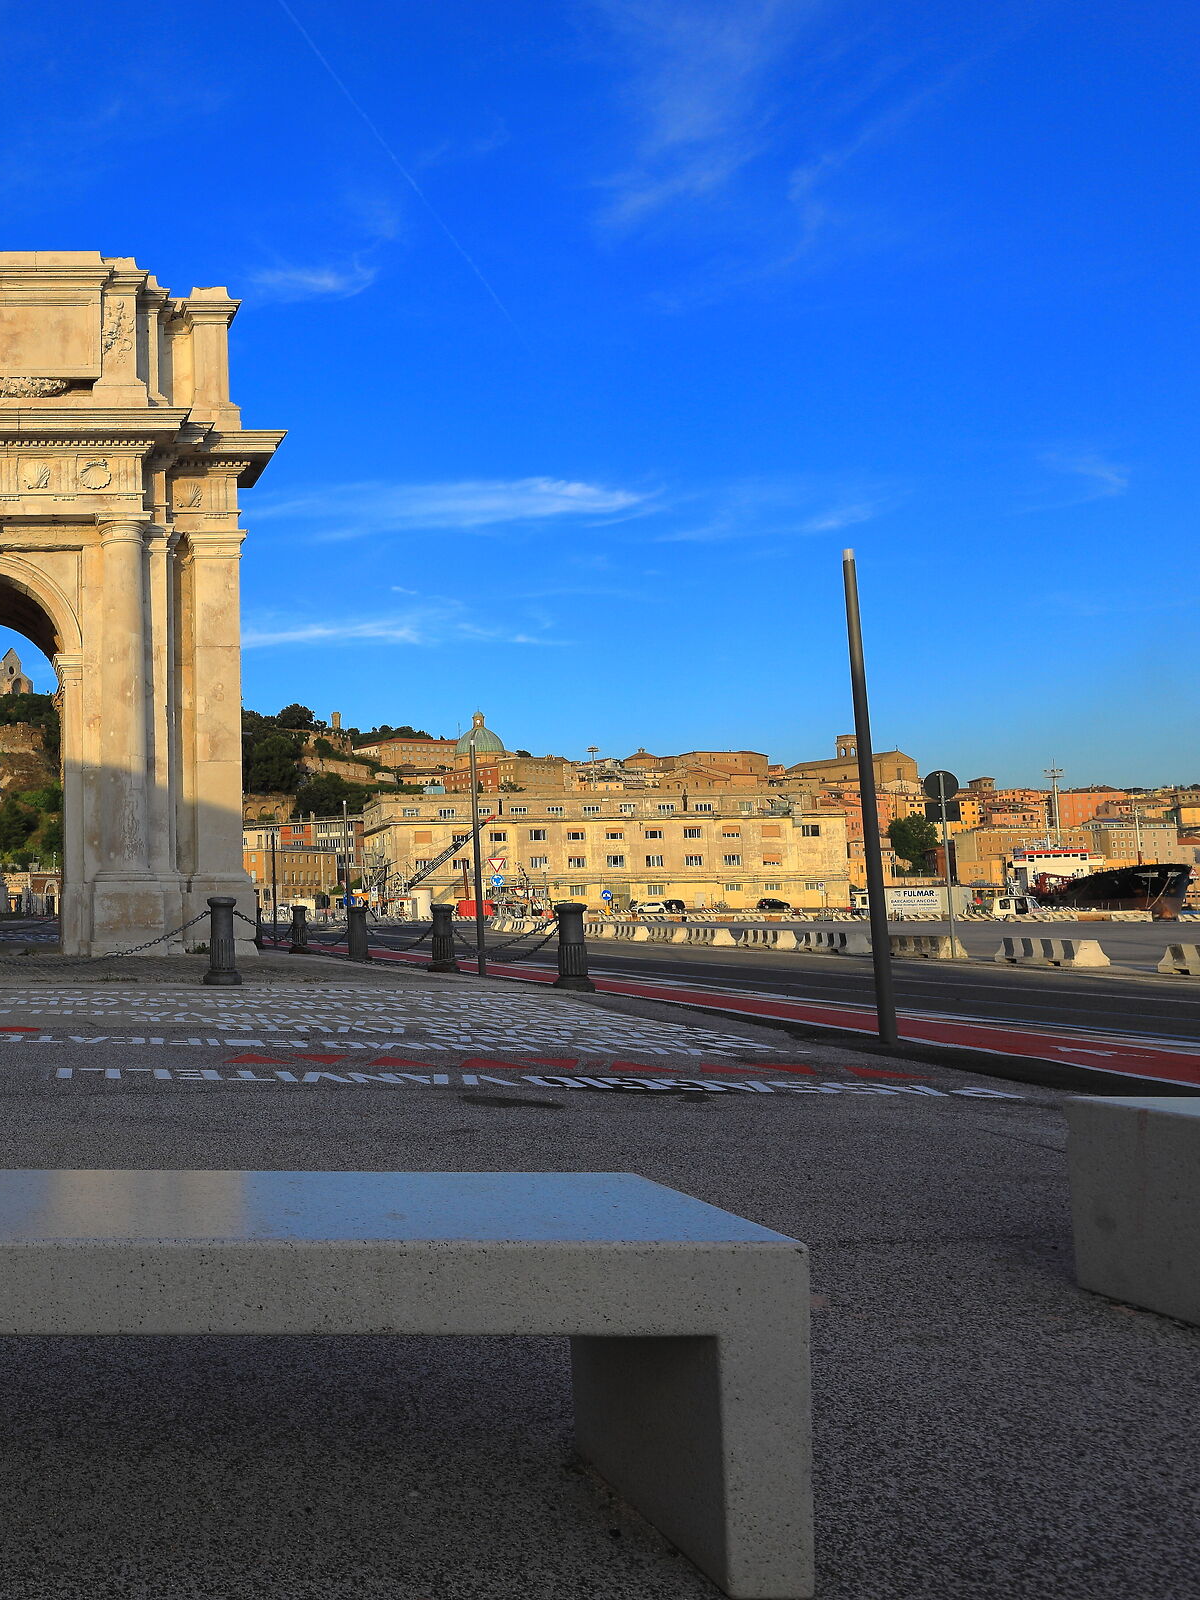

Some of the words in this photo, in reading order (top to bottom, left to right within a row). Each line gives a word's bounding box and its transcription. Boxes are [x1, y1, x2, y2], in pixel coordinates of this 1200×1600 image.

[130, 1016, 324, 1024] MENTE
[213, 1023, 415, 1033] AVUTO
[416, 1027, 587, 1037] AVER
[427, 1034, 700, 1046] ANCONA
[581, 1031, 759, 1041] DEVE
[316, 1040, 545, 1051] PRIMO
[545, 1044, 624, 1053] IL
[615, 1046, 745, 1056] MA
[53, 1067, 519, 1086] VANVITELLI
[514, 1075, 1032, 1098] PASSAGGIO
